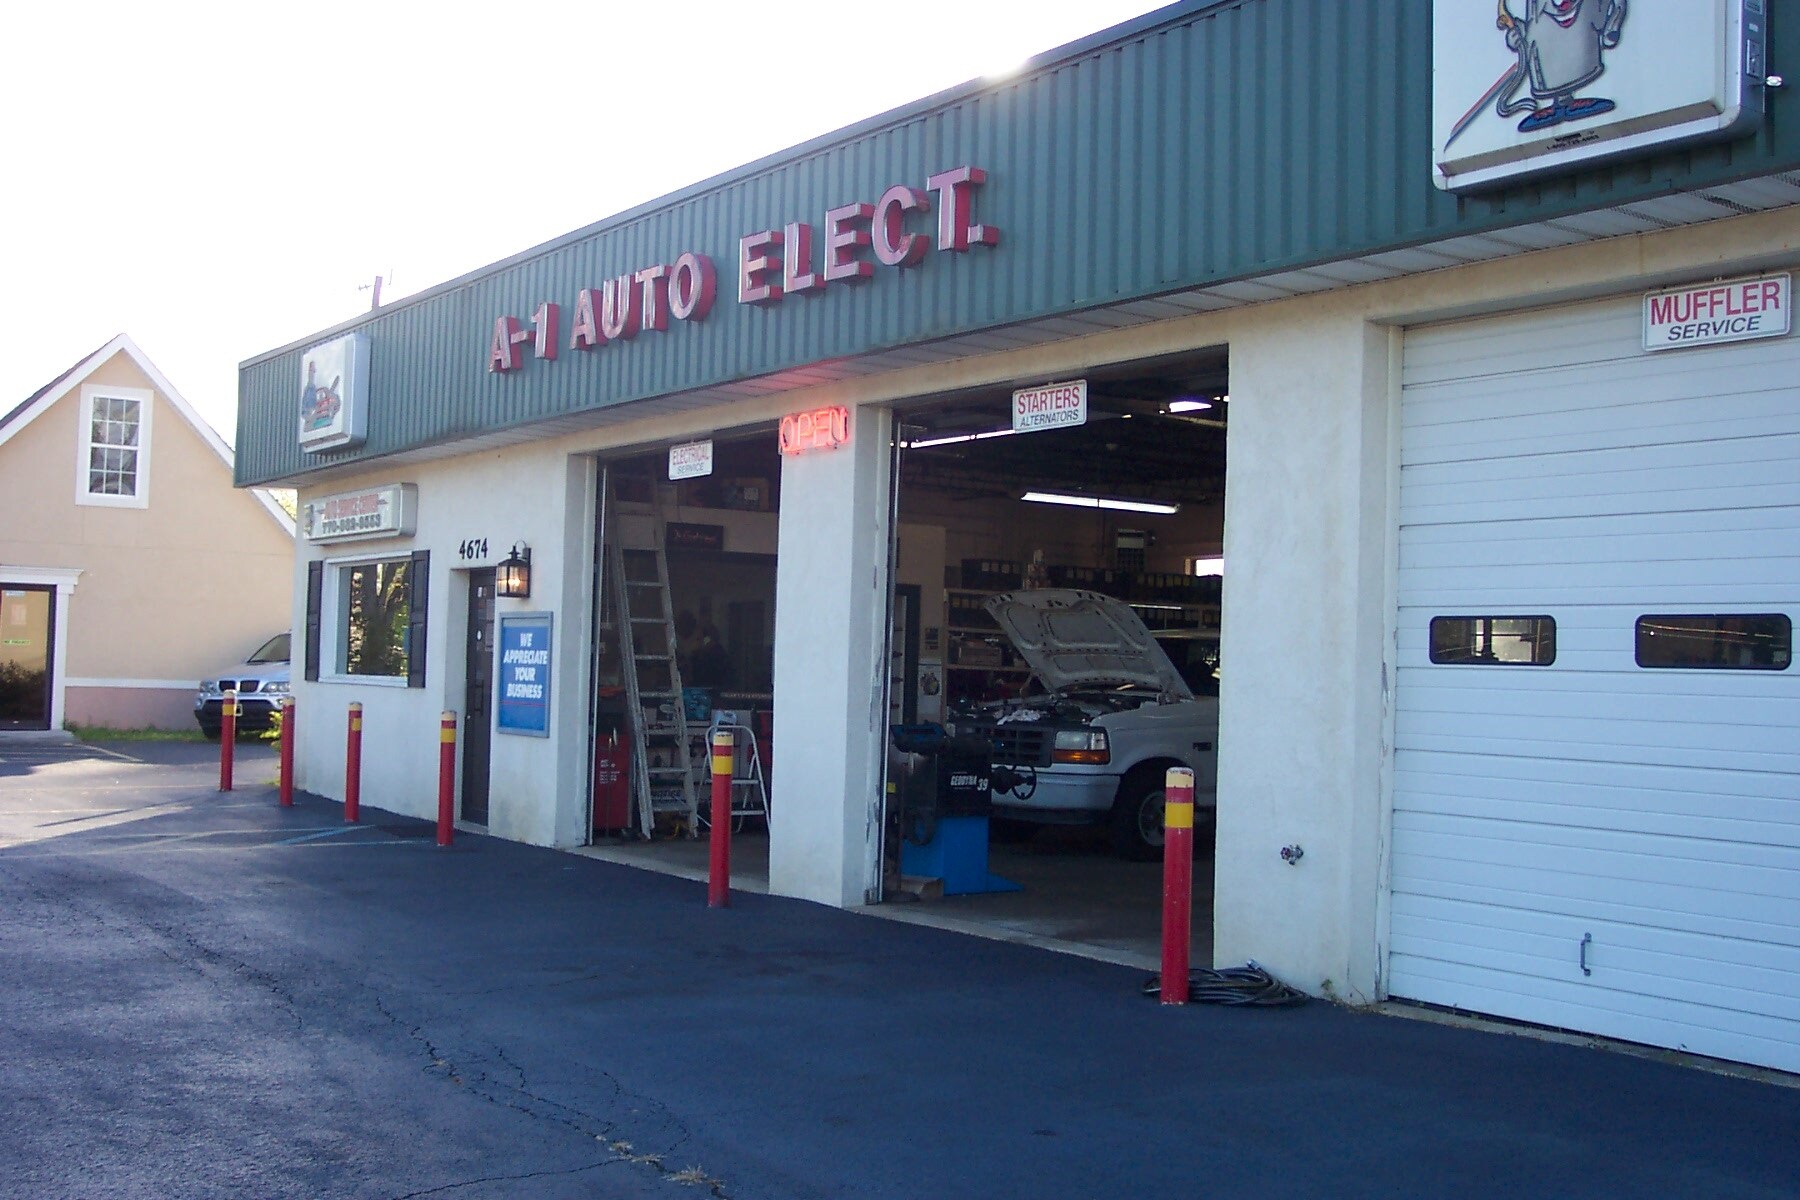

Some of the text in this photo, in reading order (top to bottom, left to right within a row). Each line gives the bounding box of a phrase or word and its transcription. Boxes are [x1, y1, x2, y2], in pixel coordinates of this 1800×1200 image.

[489, 166, 1000, 374] A-1 AUTO ELECT.
[1650, 281, 1781, 326] MUFFLER
[1667, 315, 1762, 341] SERVICE
[1018, 386, 1080, 415] STARTERS
[1021, 409, 1079, 427] ALTERNATORS
[781, 406, 848, 452] OPEN
[677, 462, 705, 475] SERVICE
[459, 538, 488, 560] 4674
[520, 632, 533, 648] WE
[503, 650, 548, 665] APPRECIATE
[515, 667, 537, 682] YOUR
[507, 683, 543, 699] BUSINESS
